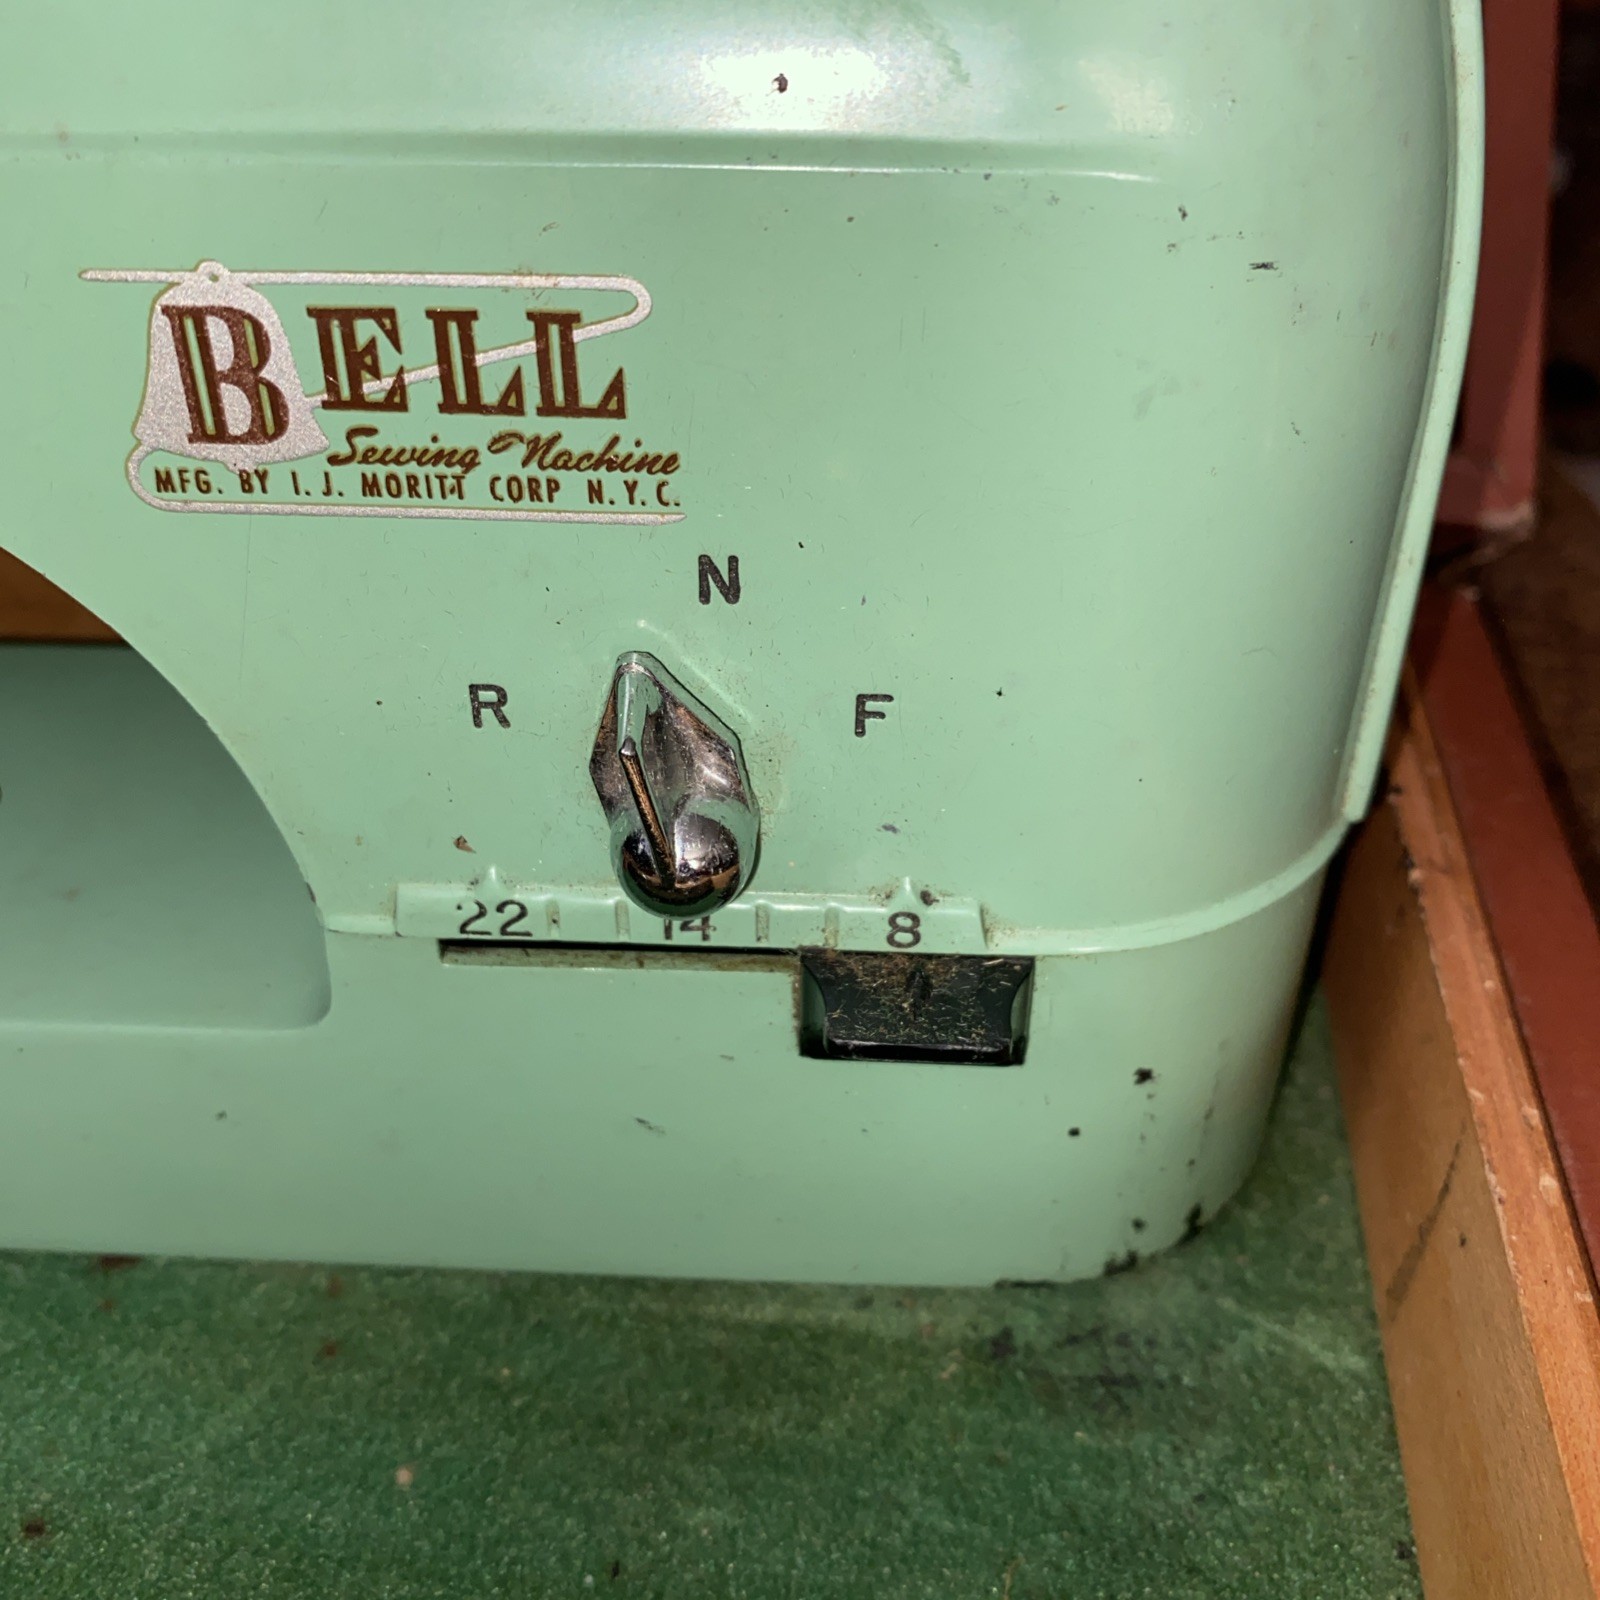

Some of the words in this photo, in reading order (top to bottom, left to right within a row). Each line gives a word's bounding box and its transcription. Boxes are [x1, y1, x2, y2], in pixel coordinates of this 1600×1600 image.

[160, 304, 628, 446] BELL
[327, 426, 481, 474] Sewing
[487, 430, 681, 475] Machine
[154, 466, 224, 495] MFG.
[238, 468, 269, 495] BY
[489, 476, 561, 503] CORP
[698, 555, 741, 605] N
[468, 683, 511, 729] R
[854, 693, 895, 738] F
[456, 899, 533, 937] 22
[886, 912, 922, 950] 8
